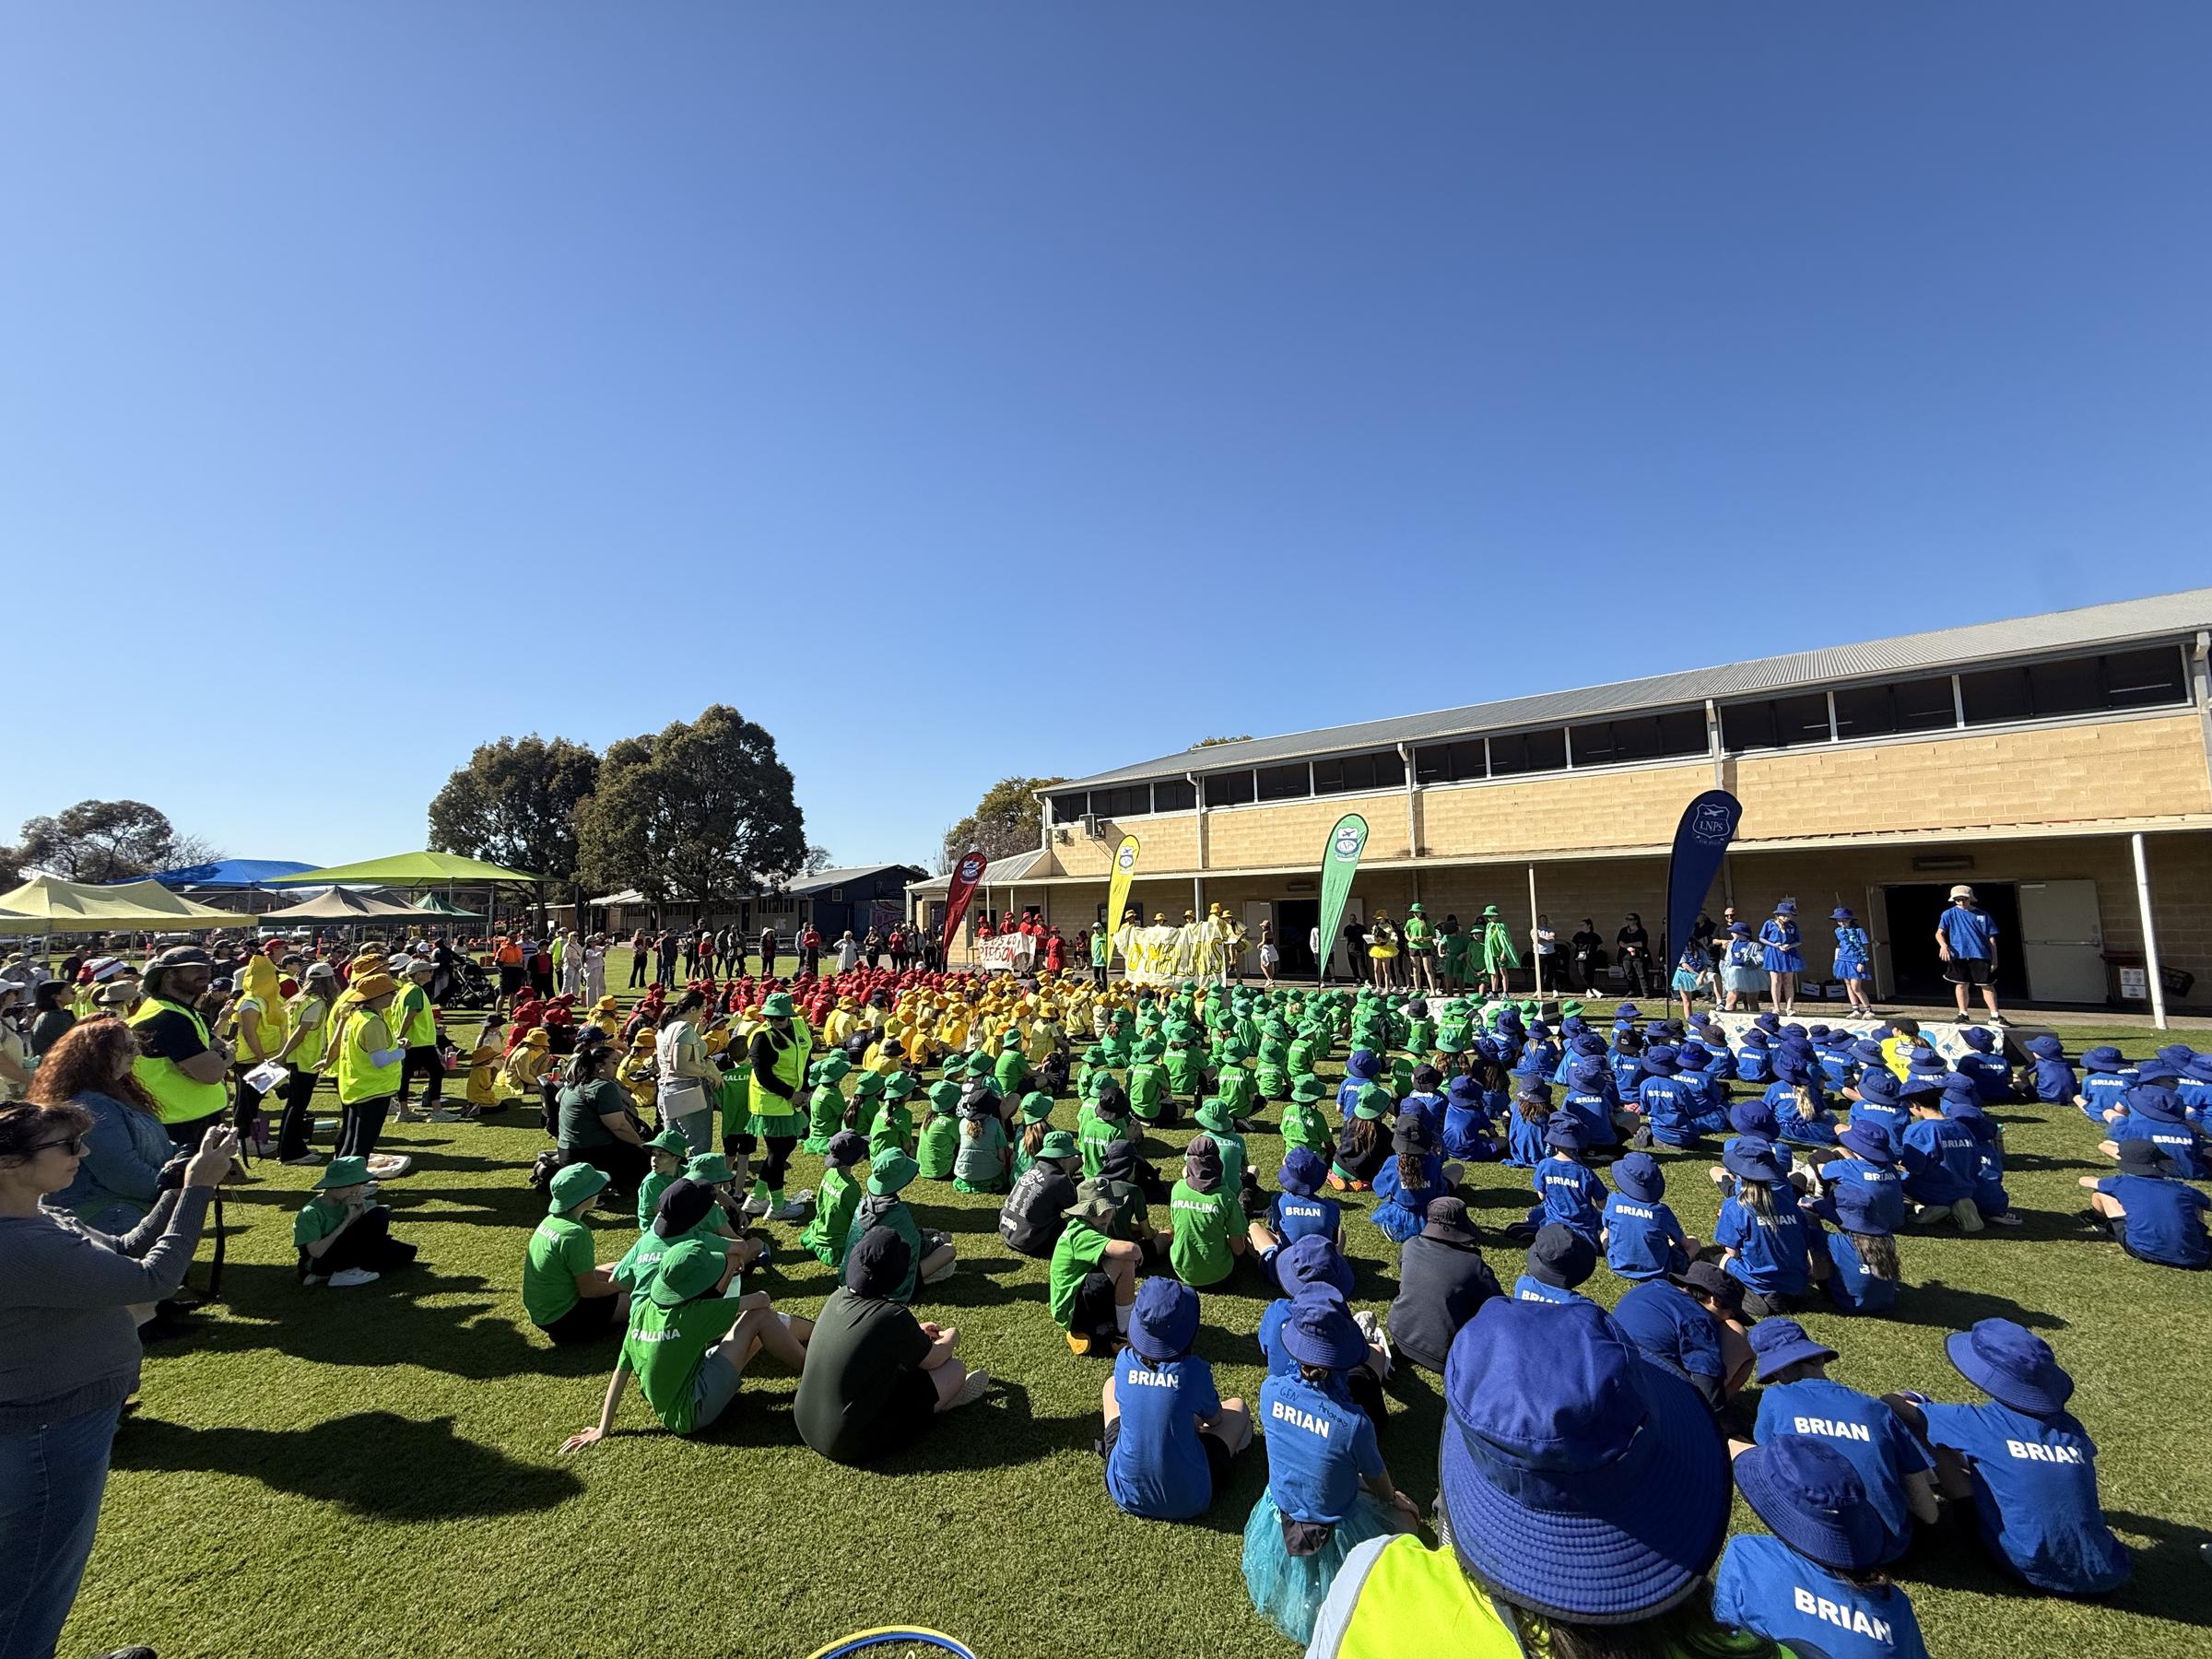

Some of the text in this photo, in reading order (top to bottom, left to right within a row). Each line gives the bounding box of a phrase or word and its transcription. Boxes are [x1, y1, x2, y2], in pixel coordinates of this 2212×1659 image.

[1700, 820, 1723, 831] LNPS
[1673, 1075, 1698, 1085] BRIAN
[2090, 1078, 2124, 1087] BRIAN
[1575, 1095, 1602, 1103] BRIAN
[1864, 1104, 1896, 1113] BRIAN
[1941, 1139, 1973, 1148] BRIAN
[2152, 1135, 2193, 1146] BRIAN
[1546, 1175, 1580, 1188] BRIAN
[1864, 1171, 1897, 1182] BRIAN
[1285, 1206, 1322, 1218] BRIAN
[1616, 1204, 1653, 1219] BRIAN
[636, 1252, 663, 1265] GRAL
[1127, 1370, 1179, 1388] BRIAN
[1272, 1400, 1330, 1439] BRIAN
[1794, 1417, 1870, 1442] BRIAN
[2006, 1439, 2086, 1465] BRIAN
[1794, 1587, 1893, 1646] BRIAN
